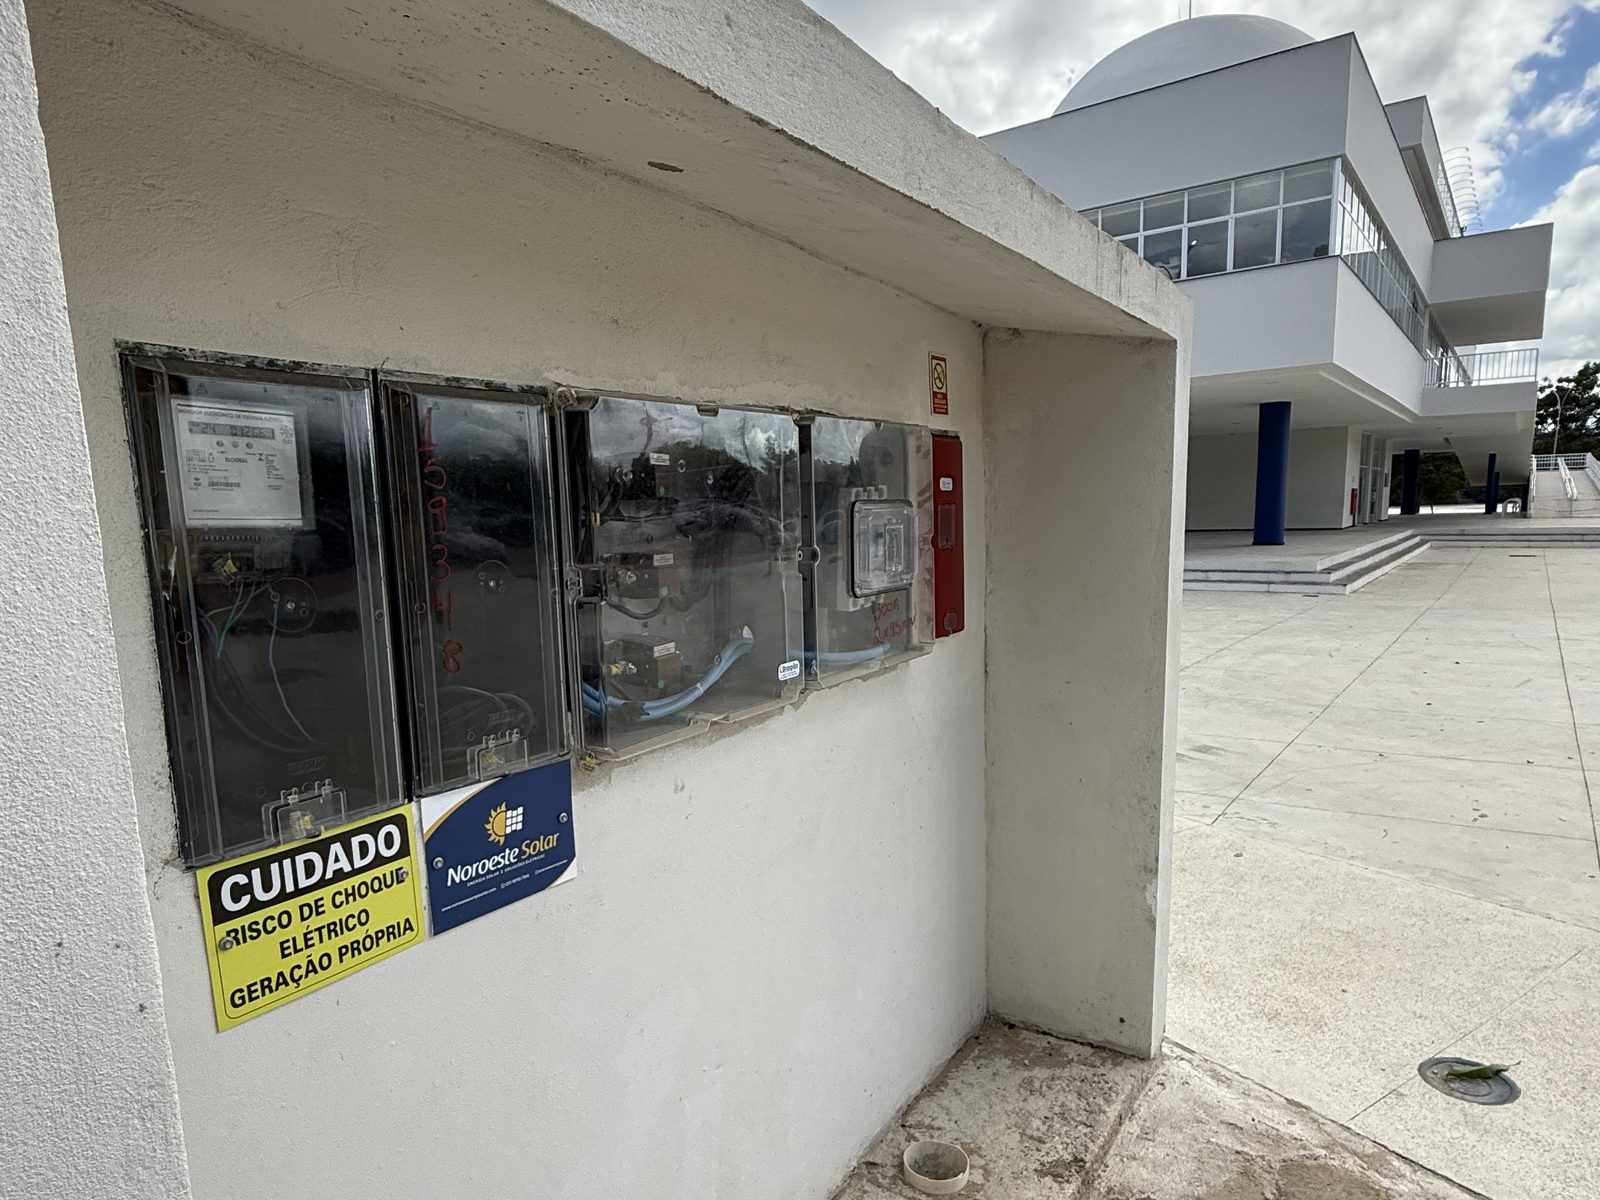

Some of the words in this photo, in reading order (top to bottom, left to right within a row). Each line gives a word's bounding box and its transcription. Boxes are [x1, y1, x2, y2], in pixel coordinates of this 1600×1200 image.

[220, 824, 402, 912] CUIDADO
[447, 848, 519, 887] Noroeste
[521, 832, 560, 859] Solar
[226, 910, 293, 948] RISCO
[299, 898, 326, 922] DE
[332, 867, 406, 910] CHOQUE
[279, 909, 370, 960] ELÉTRICO
[230, 951, 332, 1009] GERAÇÃO
[338, 917, 415, 967] PRÓPRIA
